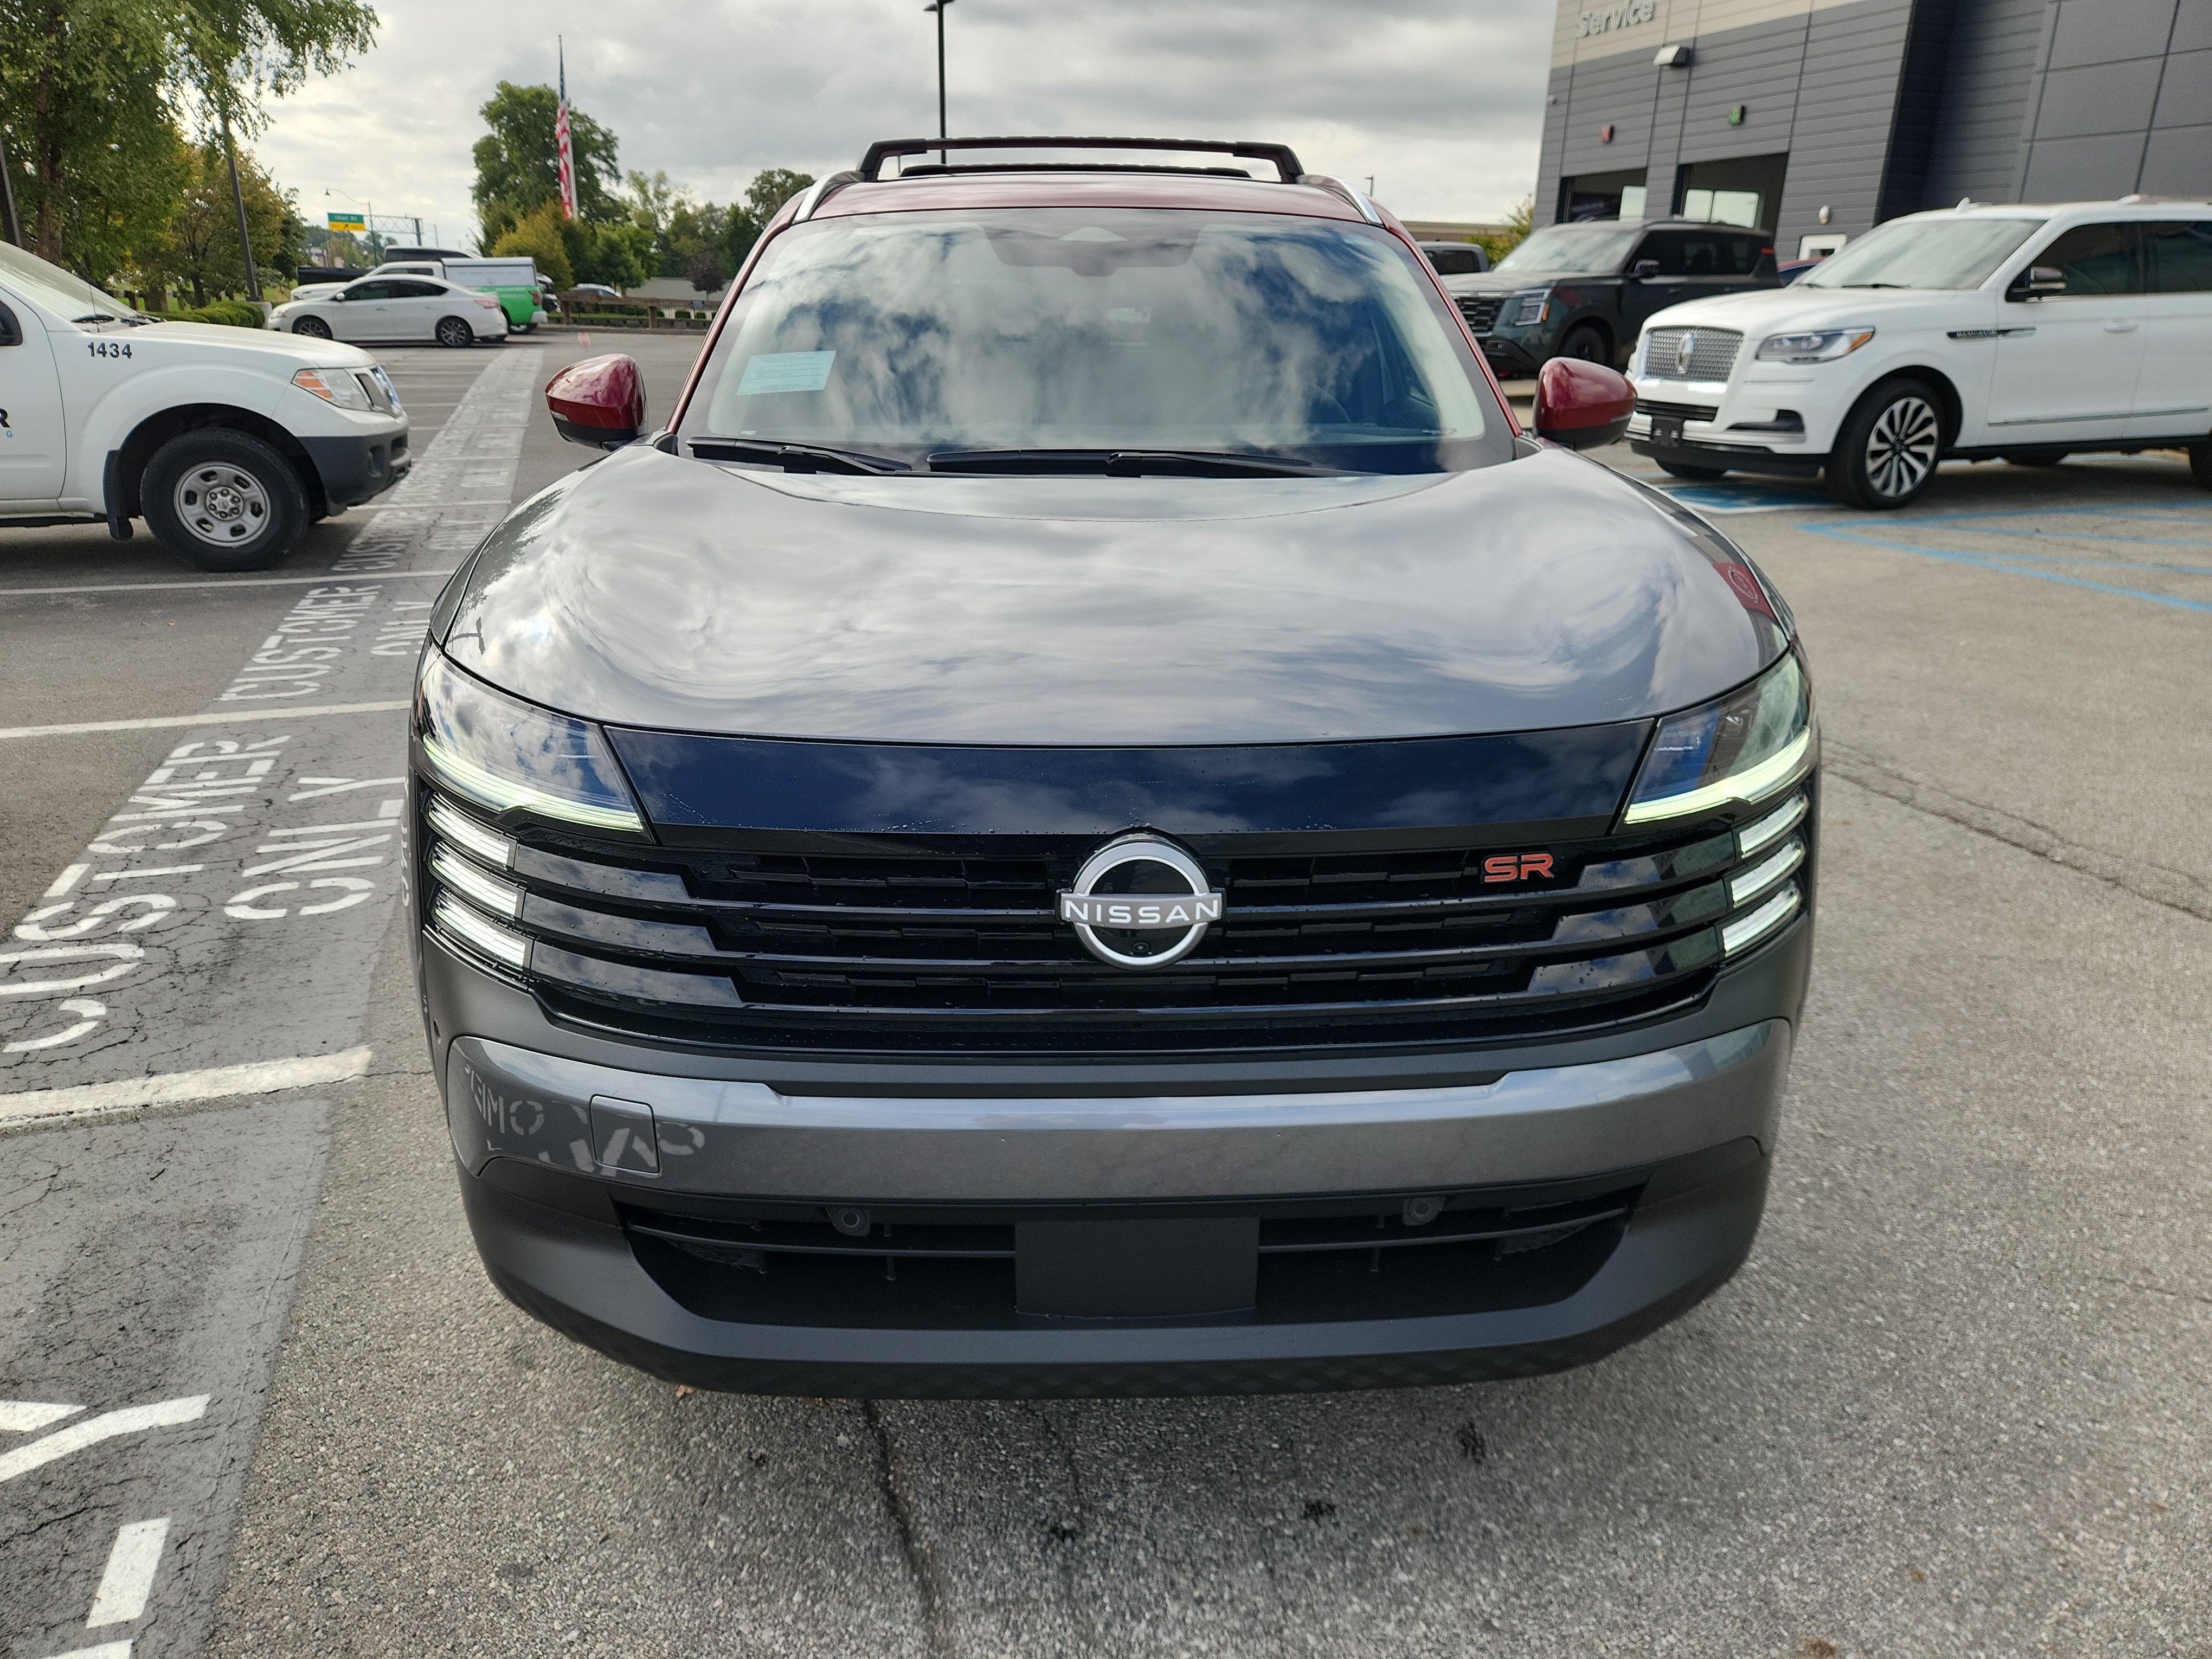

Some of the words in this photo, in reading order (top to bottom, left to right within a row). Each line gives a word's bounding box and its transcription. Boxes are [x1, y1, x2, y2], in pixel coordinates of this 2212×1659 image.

[1576, 0, 1655, 37] Service
[87, 342, 132, 359] 1434
[217, 585, 383, 701] CUSTOMER
[223, 776, 406, 920] ONLY
[1484, 853, 1554, 883] SR
[0, 735, 291, 1054] CUSTOMER
[1065, 899, 1218, 923] NISSAN
